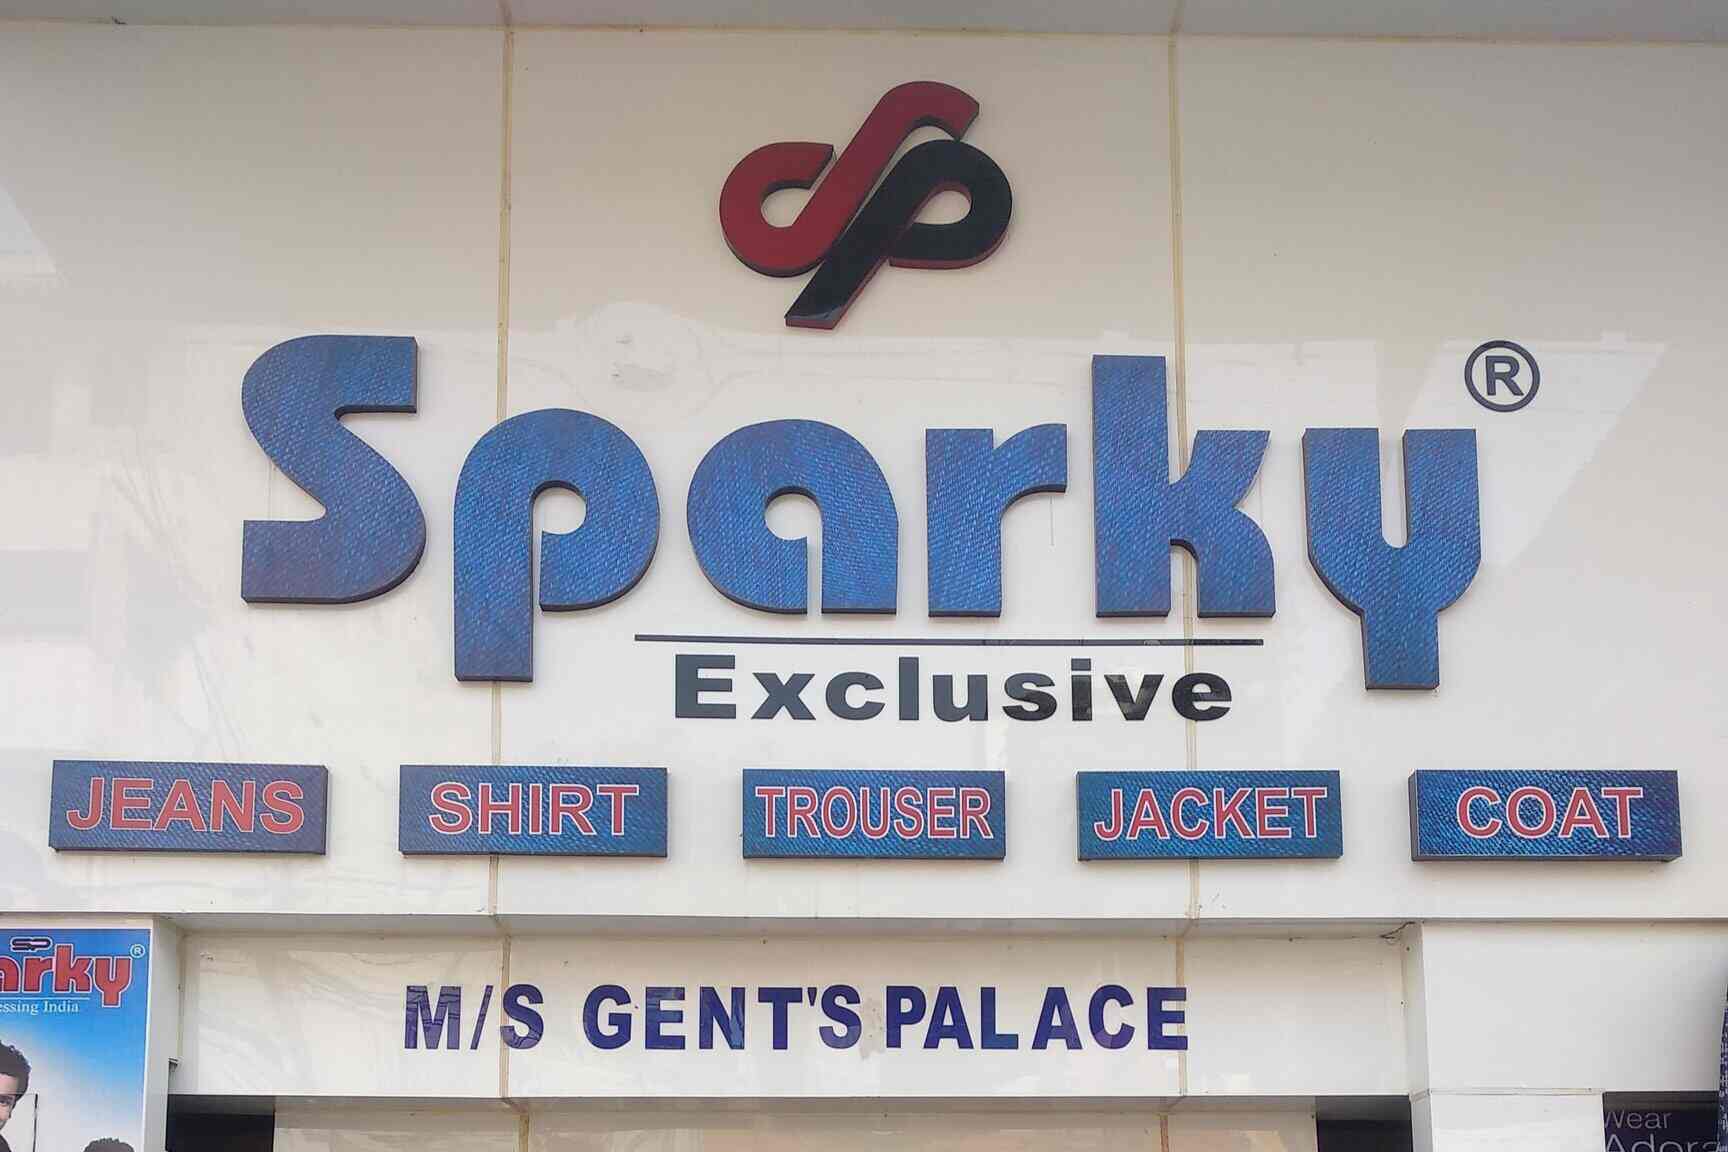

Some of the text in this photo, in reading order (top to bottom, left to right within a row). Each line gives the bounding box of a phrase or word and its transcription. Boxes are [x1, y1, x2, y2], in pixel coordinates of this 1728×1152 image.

[242, 336, 1482, 690] Sparky
[675, 654, 1232, 722] Exclusive
[65, 776, 305, 833] JEANS
[429, 780, 641, 837] SHIRT
[755, 785, 994, 841] TROUSER
[1093, 786, 1328, 841] JACKET
[1456, 785, 1644, 840] COAT
[43, 1000, 79, 1013] India
[404, 983, 1189, 1051] M/S GENT'S PALACE
